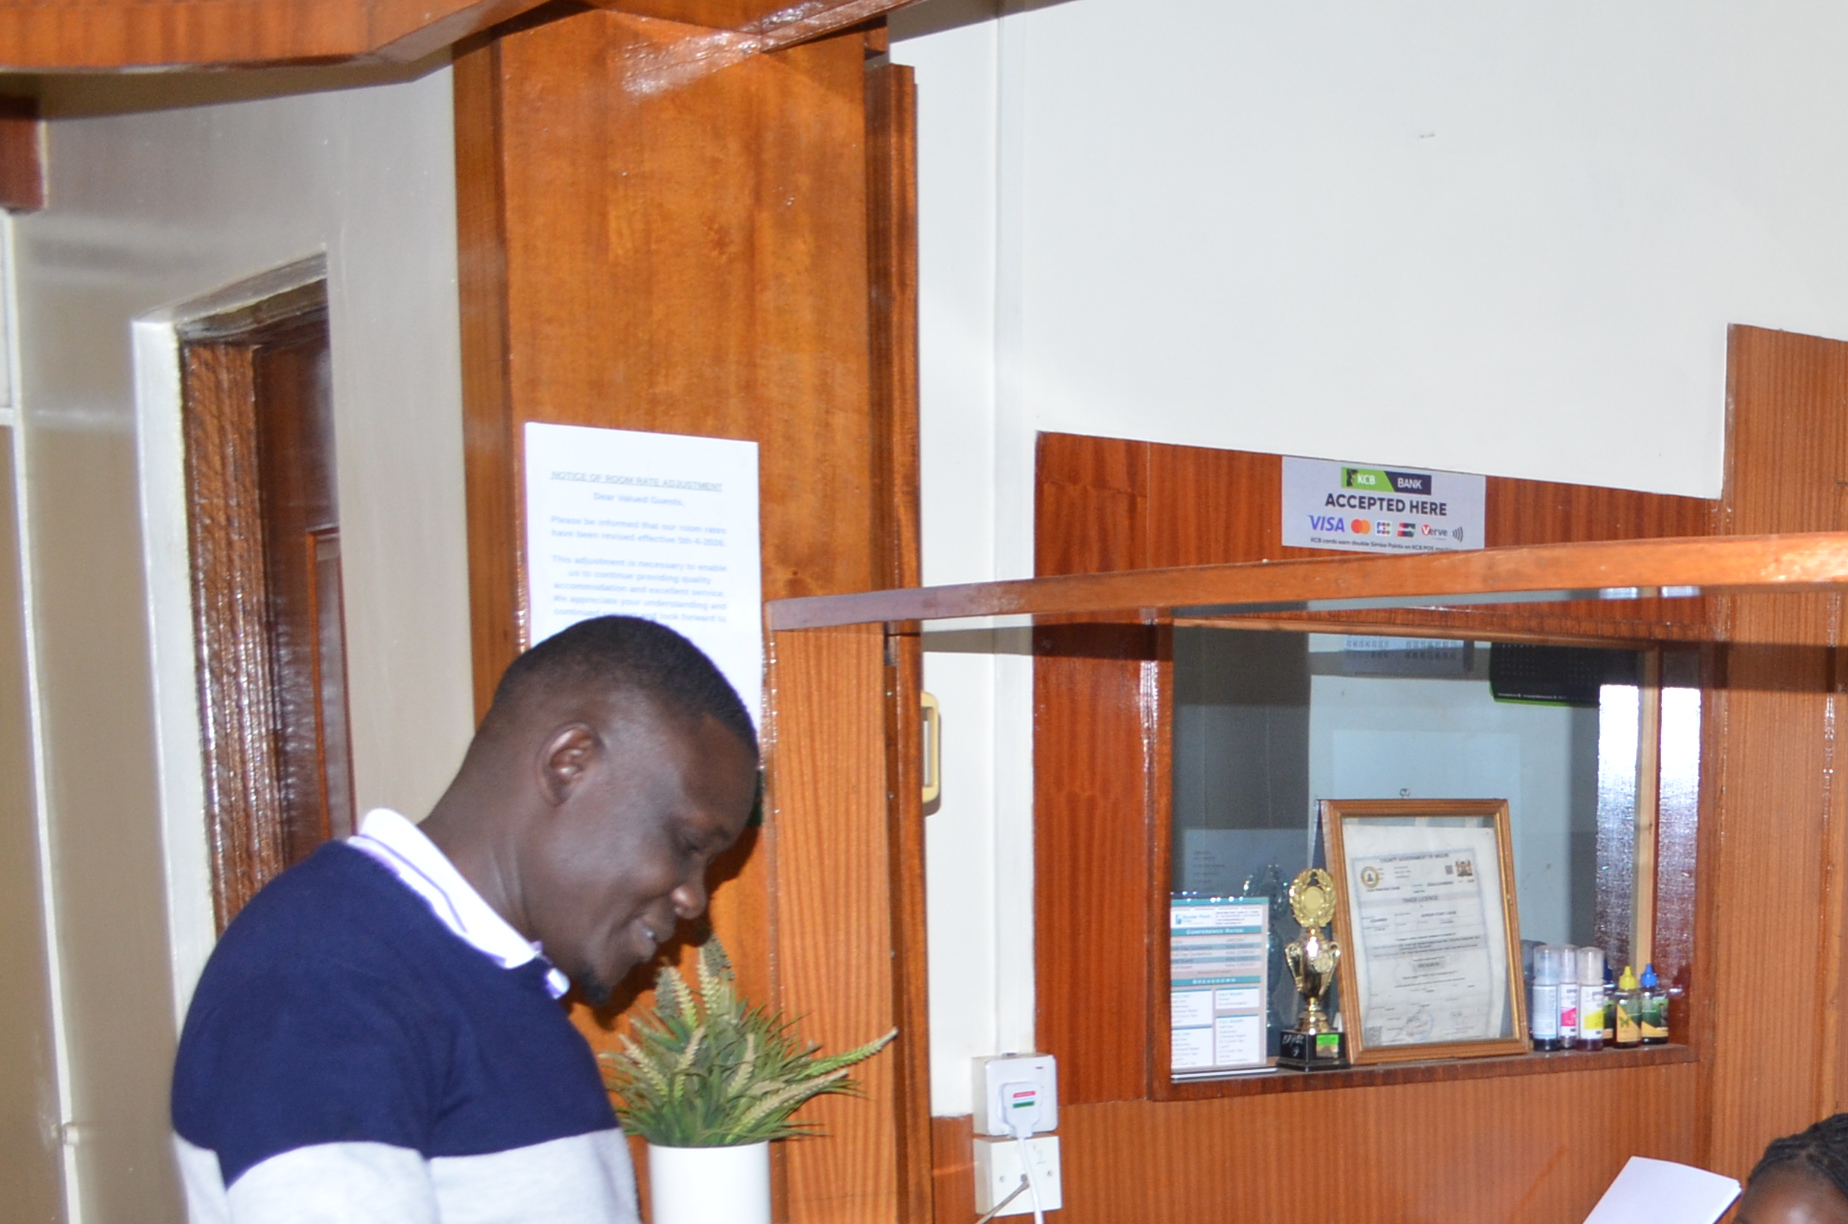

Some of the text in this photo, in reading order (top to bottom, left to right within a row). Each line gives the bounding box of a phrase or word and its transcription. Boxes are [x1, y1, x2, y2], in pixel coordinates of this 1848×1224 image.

[551, 471, 723, 490] NOTICE OF ROOM RATE ADJUSTMENT
[1357, 473, 1422, 490] KCB BANK
[593, 492, 615, 501] Dear
[617, 494, 648, 503] Valued
[1325, 493, 1447, 516] ACCEPTED HERE
[551, 515, 581, 525] Please
[584, 517, 595, 525] be
[598, 518, 639, 529] informed
[641, 521, 659, 530] that
[704, 526, 727, 534] rates
[1308, 515, 1448, 537] VISA Verve
[551, 529, 574, 537] have
[576, 531, 599, 539] been
[601, 532, 635, 541] revised
[637, 534, 675, 543] effective
[551, 554, 727, 571] This adjustment is necessary to enable
[594, 570, 634, 579] continue
[636, 573, 679, 585] providing
[681, 576, 712, 586] quality
[553, 582, 627, 592] accommodation
[629, 585, 647, 593] and
[649, 586, 689, 595] excellent
[570, 595, 618, 606] appreciate
[620, 598, 641, 607] your
[643, 599, 709, 611] understanding
[711, 602, 727, 610] and
[660, 612, 679, 621] look
[681, 613, 716, 622] forward
[717, 615, 727, 623] to
